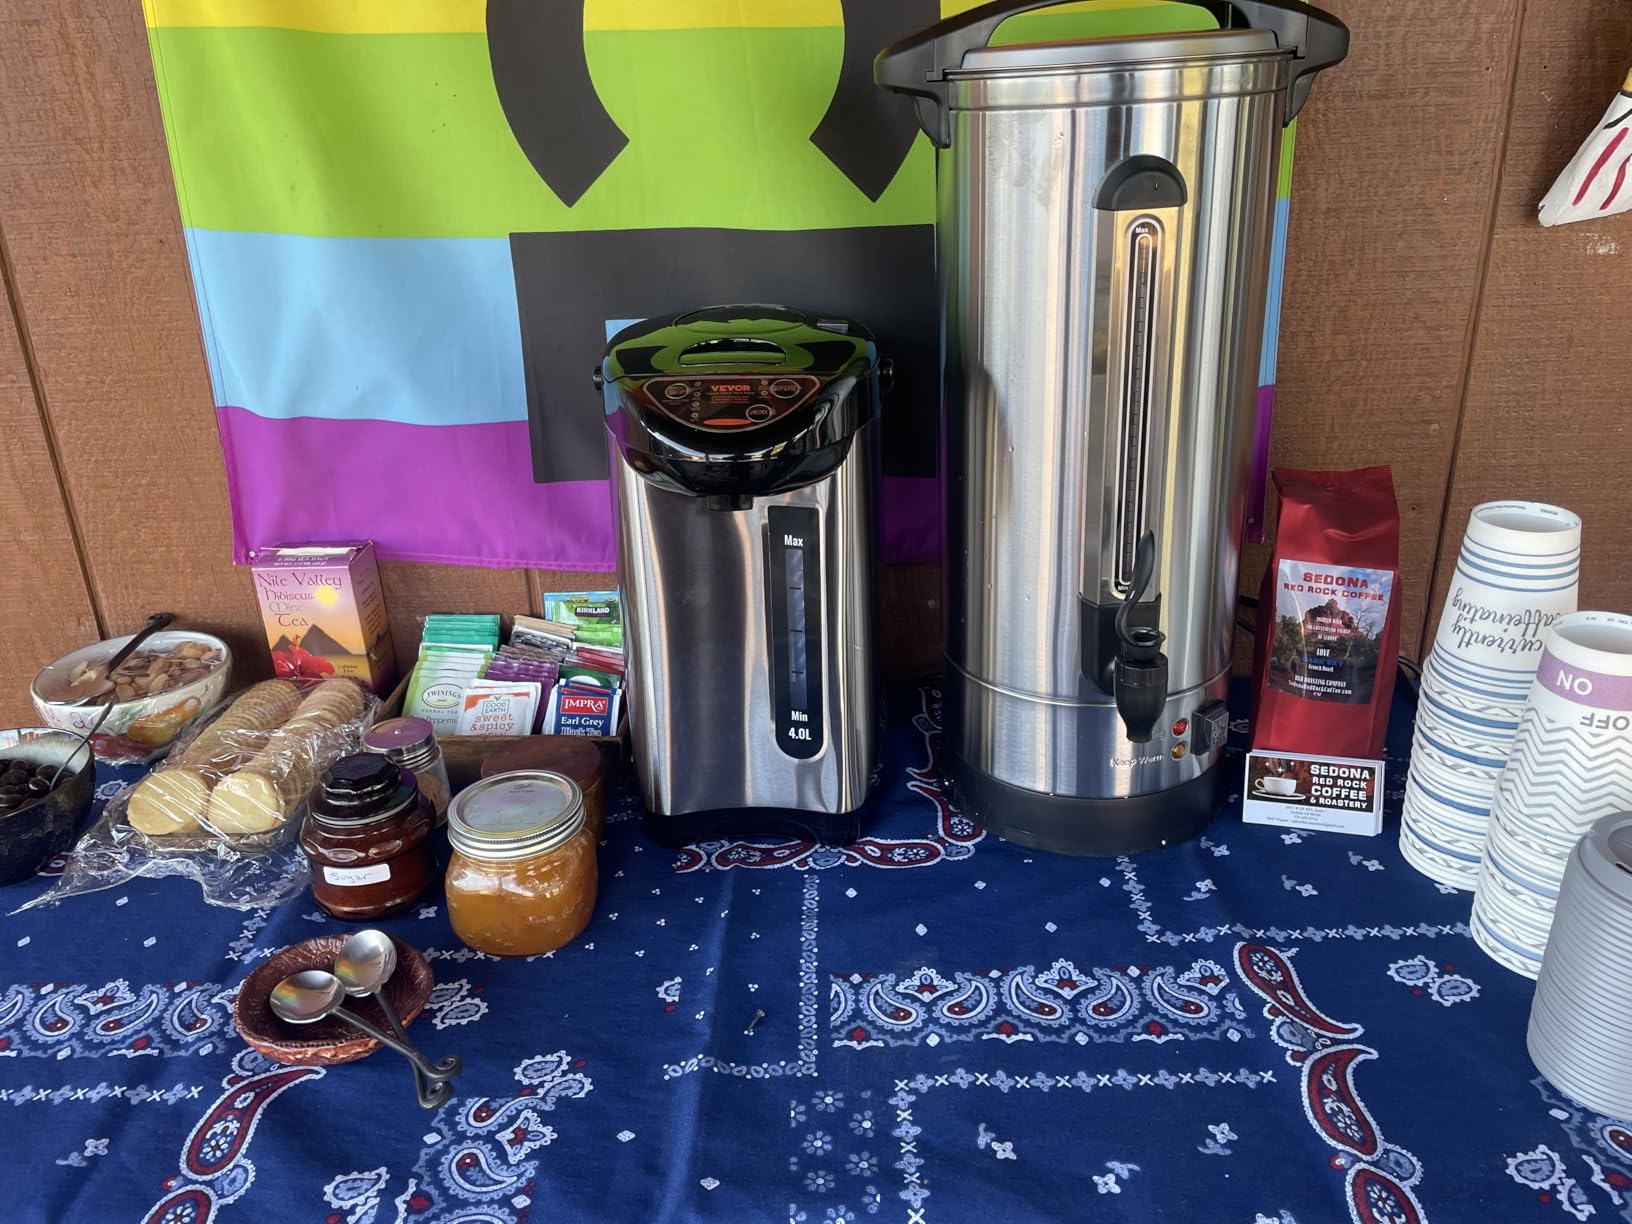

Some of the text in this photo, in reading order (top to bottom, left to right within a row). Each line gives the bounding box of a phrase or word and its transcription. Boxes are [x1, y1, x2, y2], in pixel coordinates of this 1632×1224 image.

[784, 534, 804, 547] Max
[257, 571, 342, 590] Nile Valley
[1303, 572, 1369, 589] SEDONA
[264, 586, 314, 601] Hibiscus
[1283, 583, 1385, 601] RED ROCK COFFEE
[274, 613, 309, 627] Tea
[1451, 613, 1543, 654] currently
[1316, 648, 1330, 657] LOVE
[1556, 669, 1593, 696] ON
[427, 689, 461, 699] TWININGS
[565, 698, 604, 713] IMPRA
[475, 713, 513, 723] sweet
[561, 716, 604, 726] Earl Grey
[791, 710, 808, 722] Min
[1579, 712, 1630, 731] OFF
[560, 727, 602, 736] Black Tea
[788, 727, 812, 740] 4.0L
[1110, 757, 1137, 768] Keep
[1310, 764, 1370, 780] SEDONA
[1312, 777, 1368, 789] RED ROCK
[1311, 785, 1367, 800] COFFEE
[1319, 797, 1368, 809] ROASTERY
[329, 872, 373, 884] Sugar
